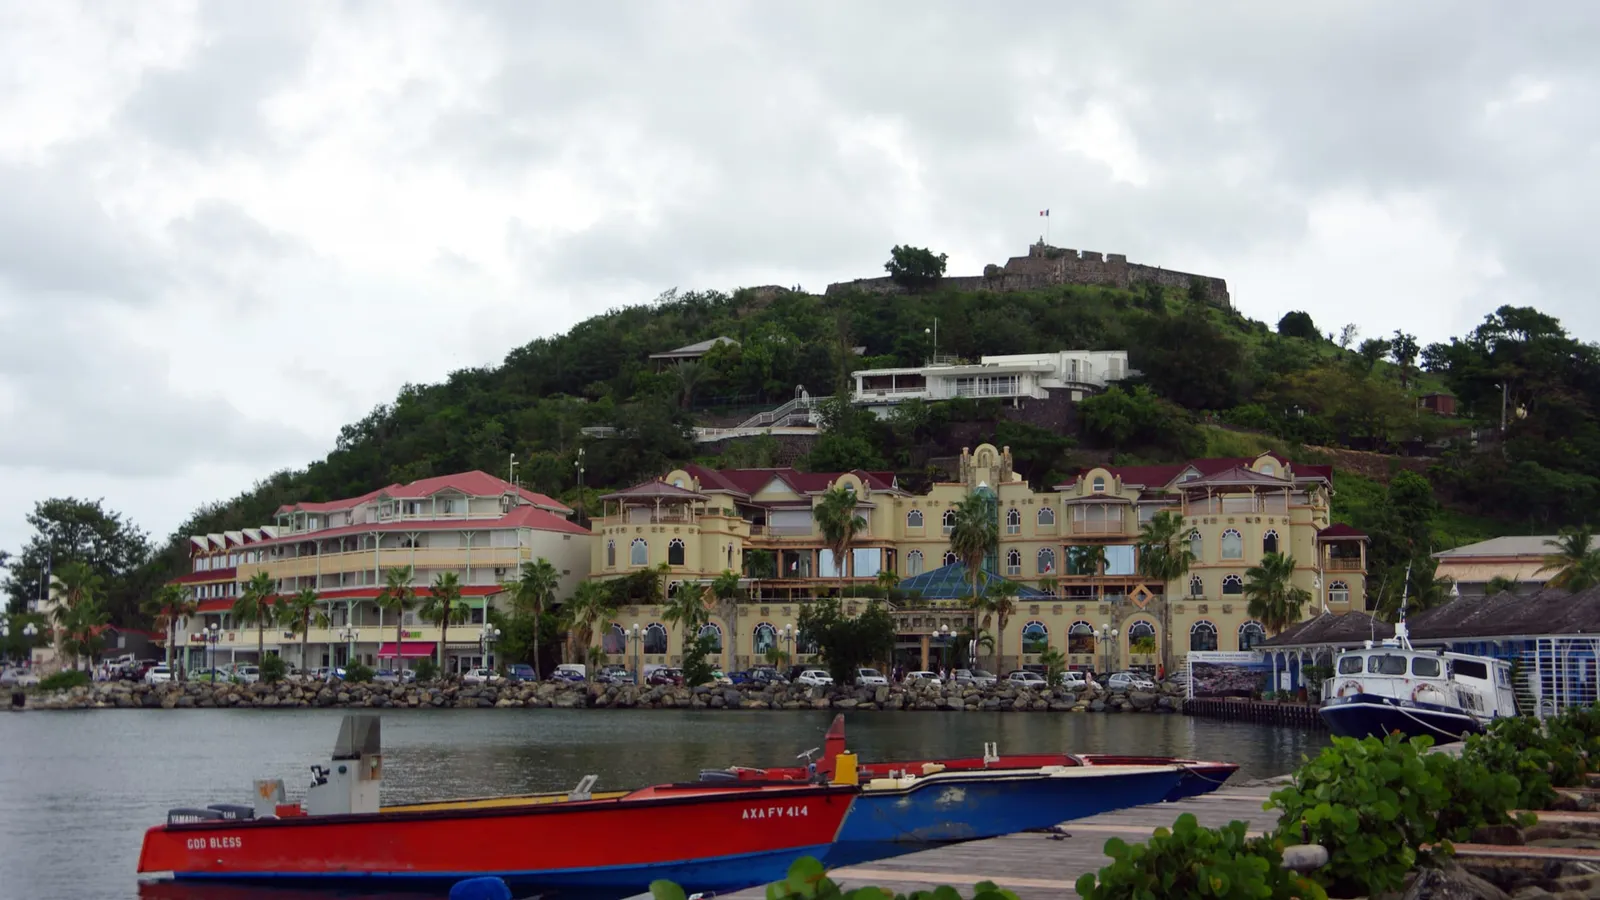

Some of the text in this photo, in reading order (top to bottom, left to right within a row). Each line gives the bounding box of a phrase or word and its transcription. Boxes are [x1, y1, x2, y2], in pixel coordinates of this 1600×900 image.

[742, 805, 808, 819] AXA FV 414
[187, 837, 242, 850] GOD BLESS
